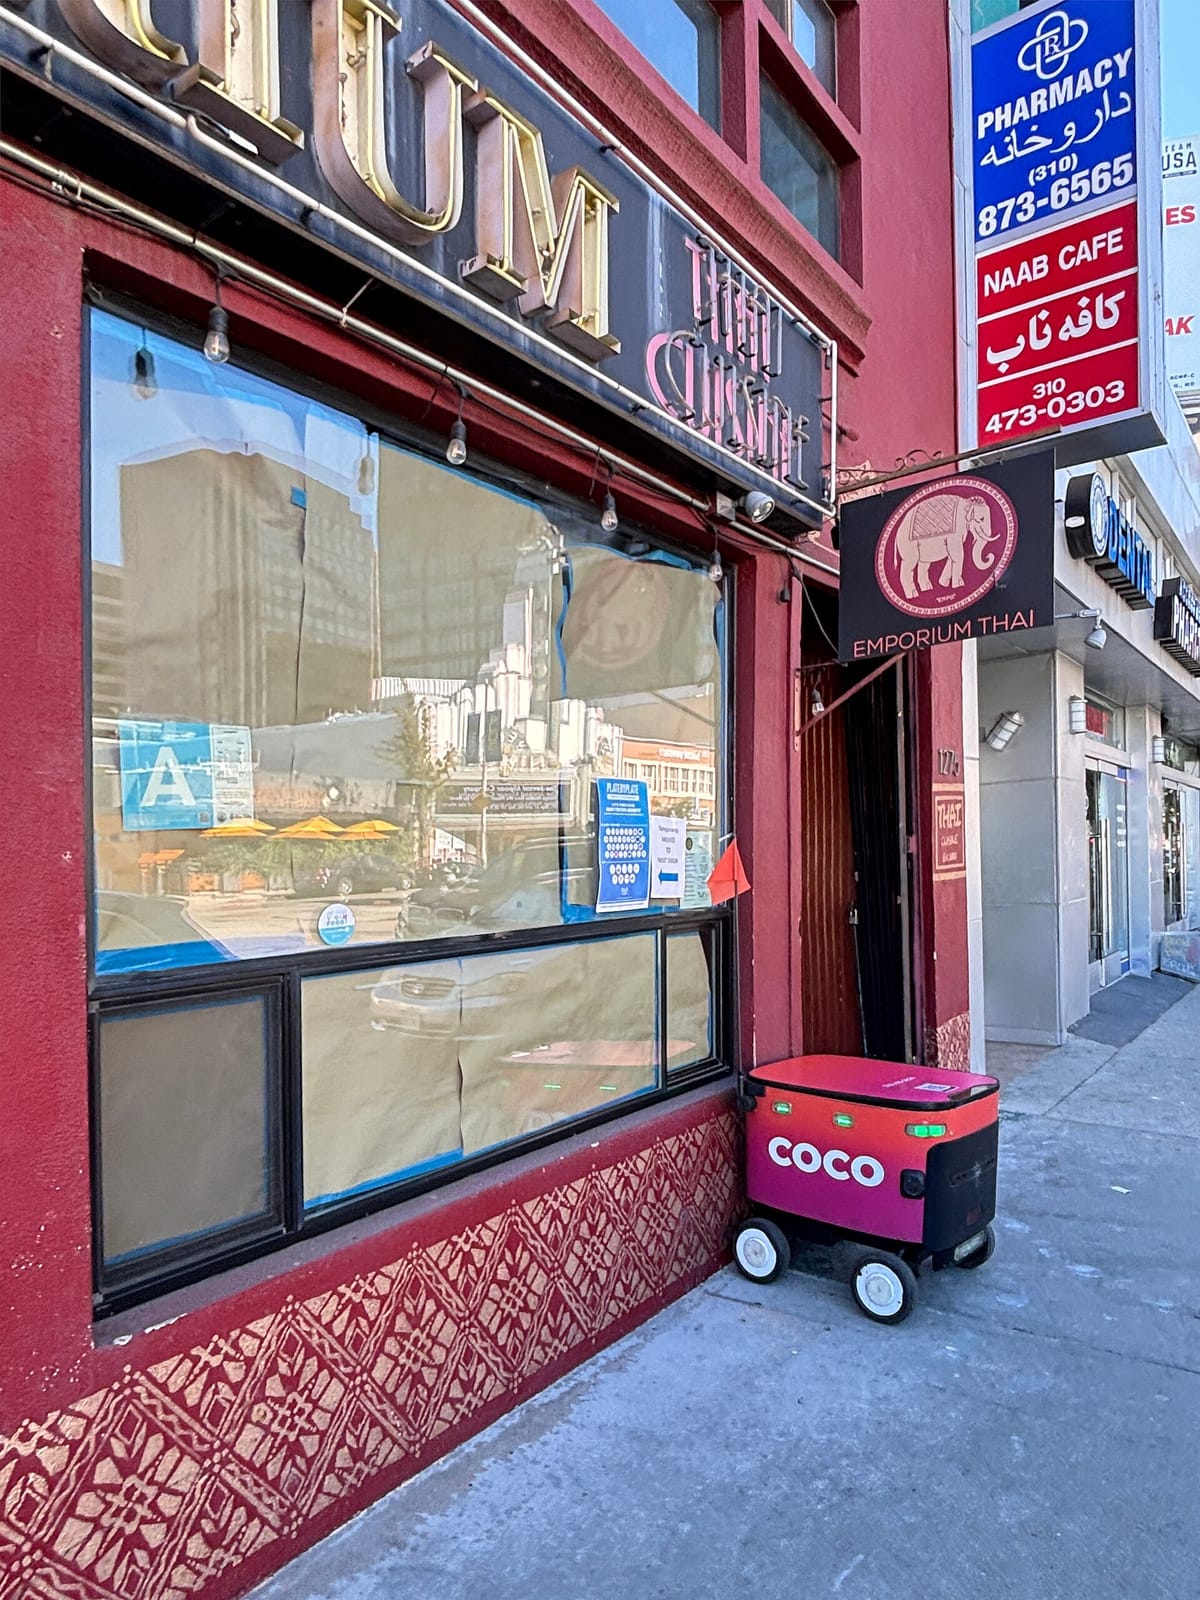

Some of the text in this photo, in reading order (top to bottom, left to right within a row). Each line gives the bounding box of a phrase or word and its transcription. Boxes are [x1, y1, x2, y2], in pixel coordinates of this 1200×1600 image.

[977, 47, 1134, 140] PHARMACY
[1027, 153, 1078, 187] (310)
[1161, 151, 1197, 172] USA
[1164, 142, 1192, 154] TEAM
[978, 152, 1134, 237] 873-6565
[983, 227, 1124, 297] NAAB CAFE
[985, 379, 1125, 434] 473-0303
[1032, 377, 1066, 400] 310
[1107, 496, 1155, 610] DENTAL
[853, 608, 1034, 658] EMPORIUM THAI
[140, 746, 197, 807] A
[937, 802, 962, 829] THAI
